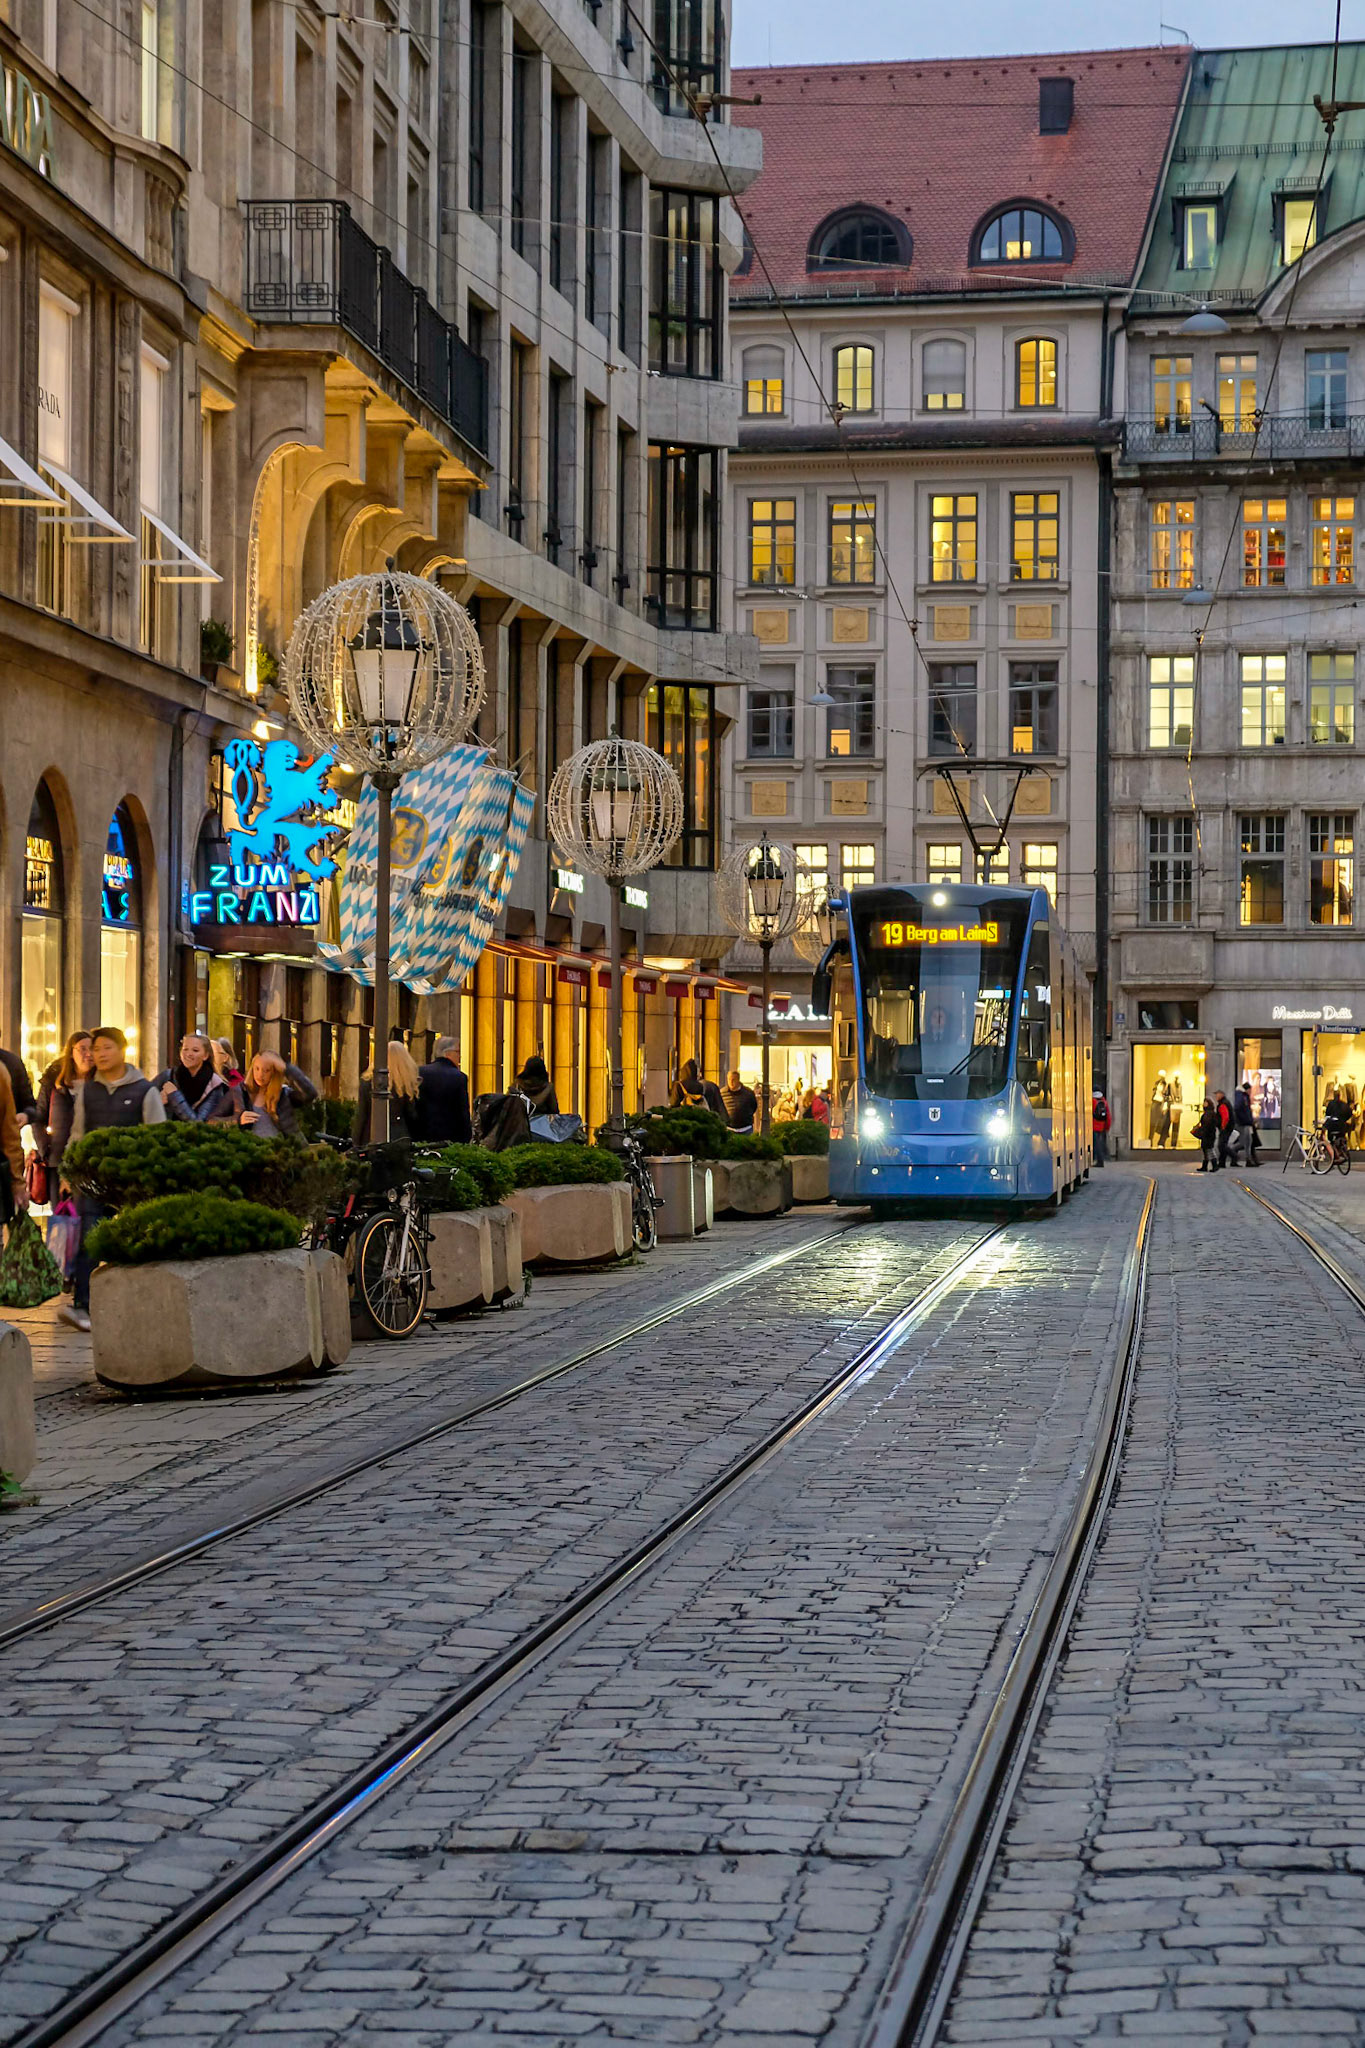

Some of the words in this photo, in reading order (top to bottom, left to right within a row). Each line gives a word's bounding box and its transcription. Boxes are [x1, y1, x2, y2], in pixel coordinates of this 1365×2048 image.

[210, 863, 289, 888] ZUM
[191, 882, 319, 925] FRANZI
[882, 923, 903, 944] 19
[906, 925, 938, 944] Berg
[940, 929, 958, 941] am
[959, 924, 987, 941] Laim
[767, 1003, 832, 1020] ZAR
